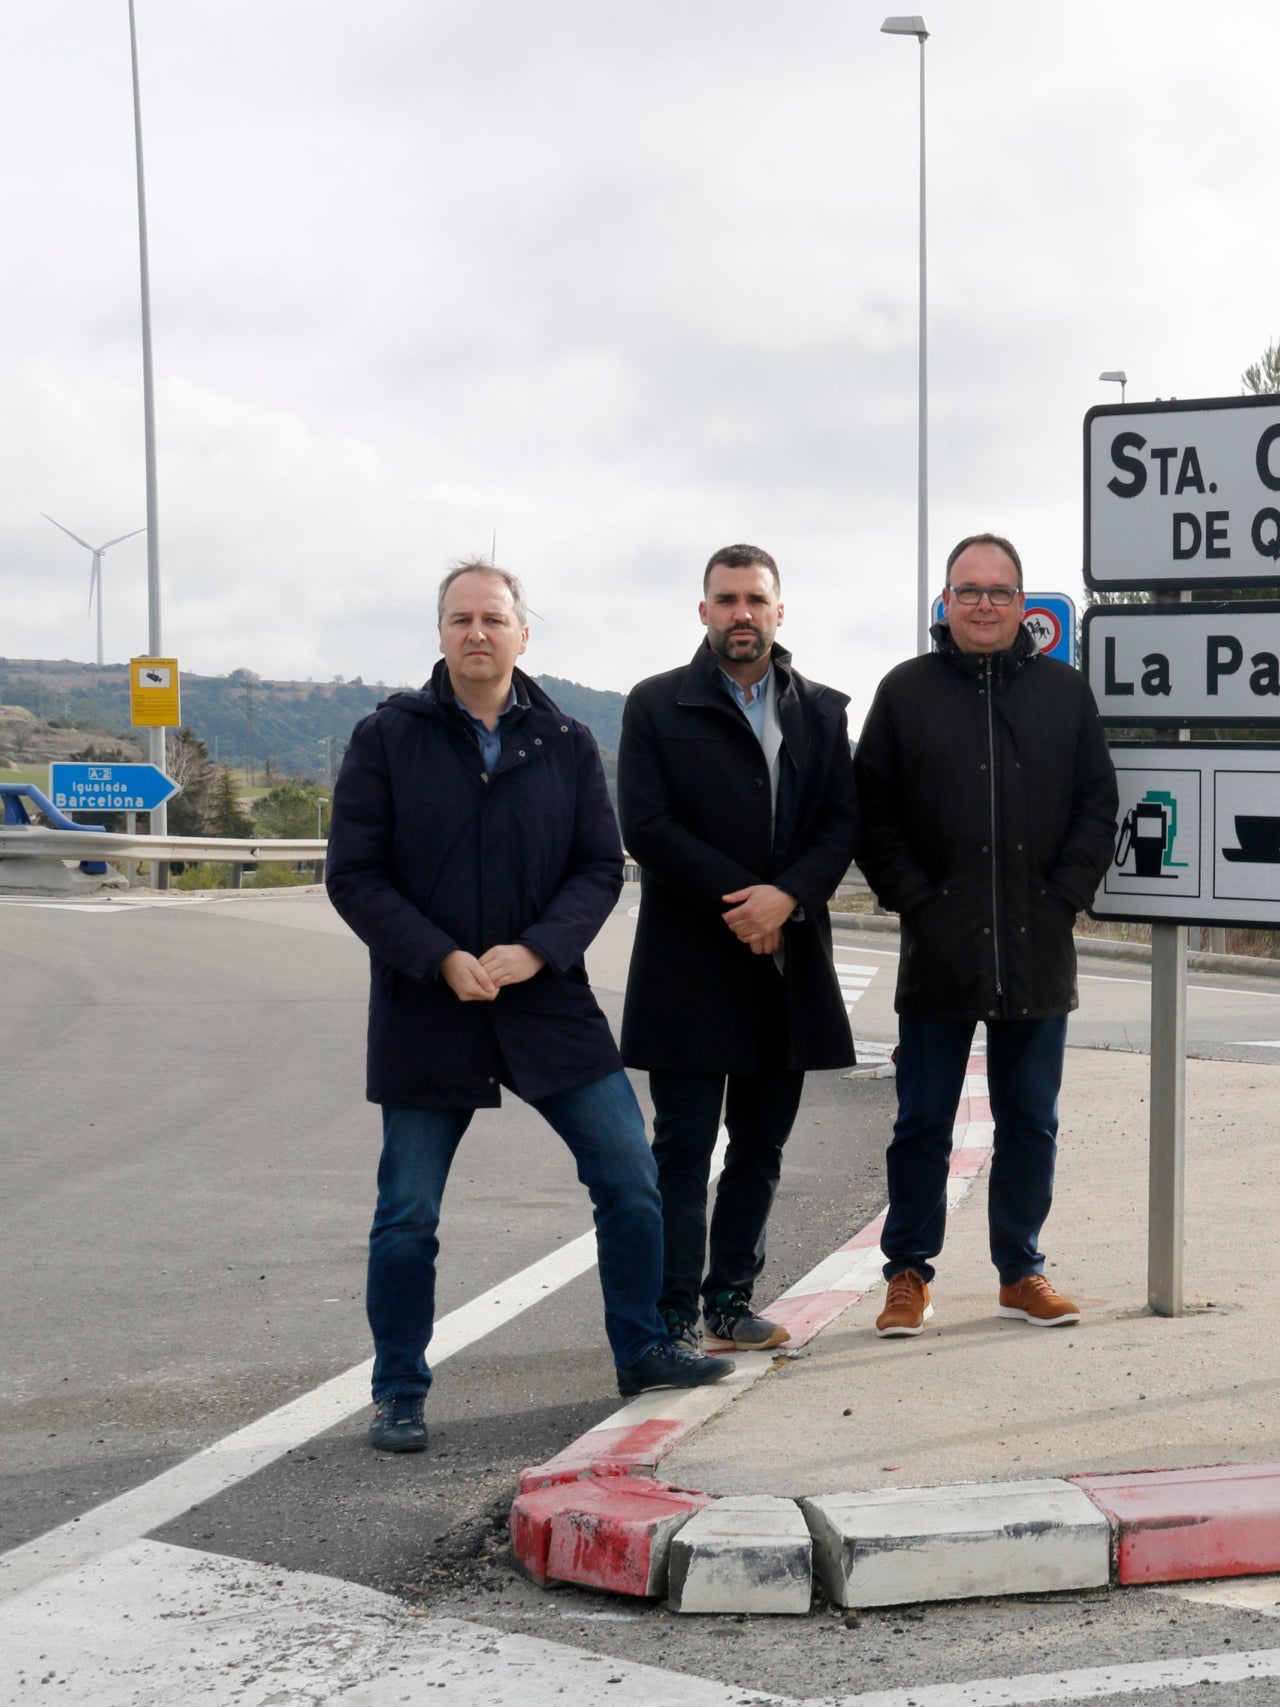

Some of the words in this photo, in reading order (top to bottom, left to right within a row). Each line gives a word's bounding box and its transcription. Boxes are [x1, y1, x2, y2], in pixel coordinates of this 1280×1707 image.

[1173, 511, 1231, 560] DE
[1104, 636, 1172, 696] La
[90, 769, 110, 779] A-2
[72, 781, 127, 794] Igualada
[56, 793, 144, 807] Barcelona
